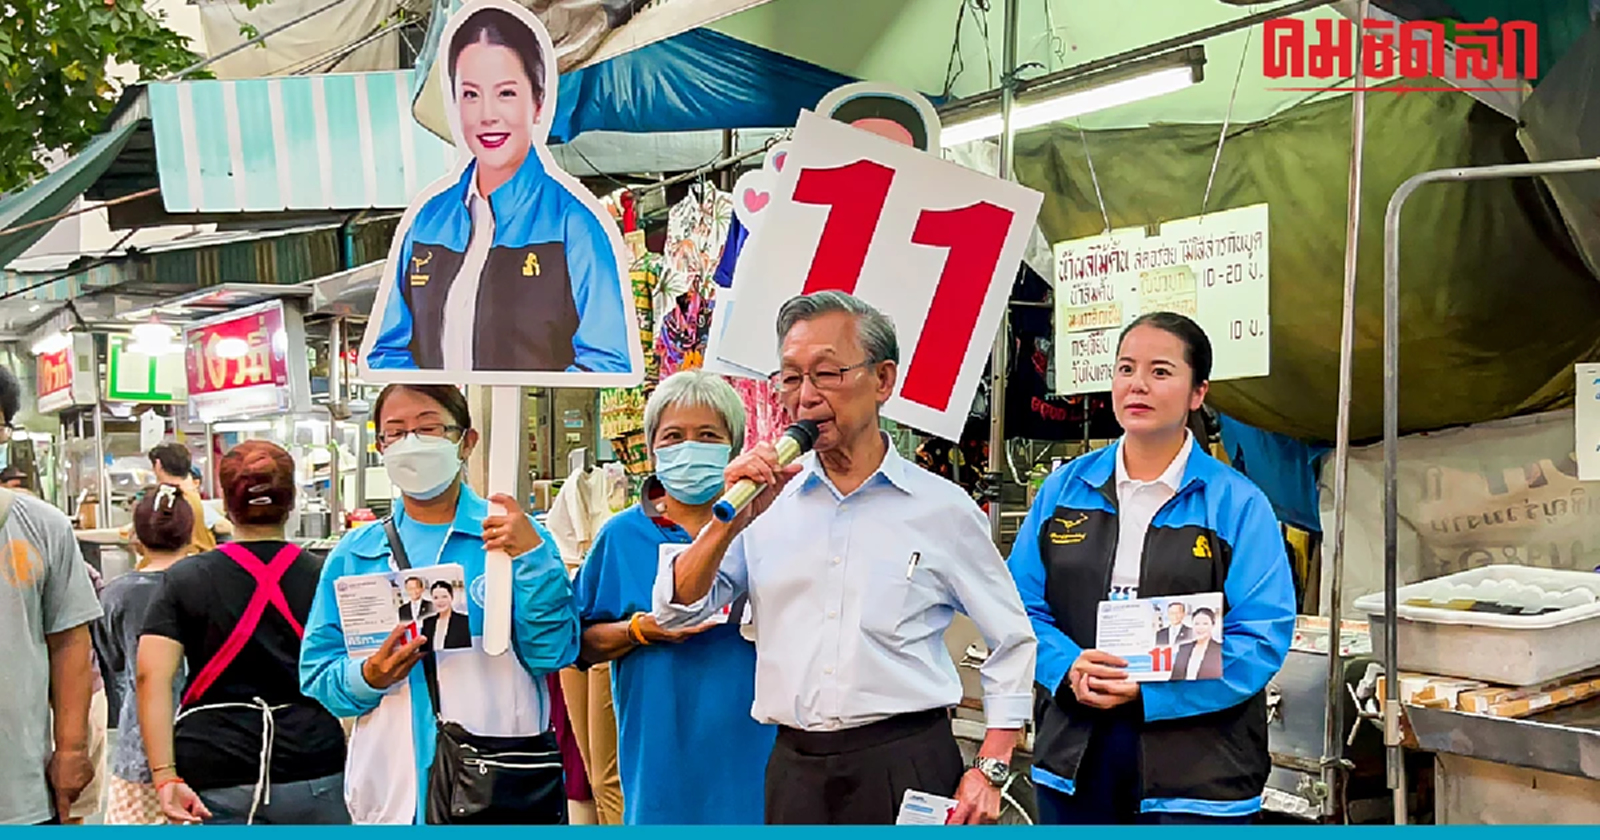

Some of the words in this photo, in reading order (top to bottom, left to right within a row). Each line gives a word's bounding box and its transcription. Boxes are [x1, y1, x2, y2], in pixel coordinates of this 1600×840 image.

[792, 159, 1015, 412] 11
[1230, 320, 1242, 340] 10
[1149, 647, 1172, 672] 11
